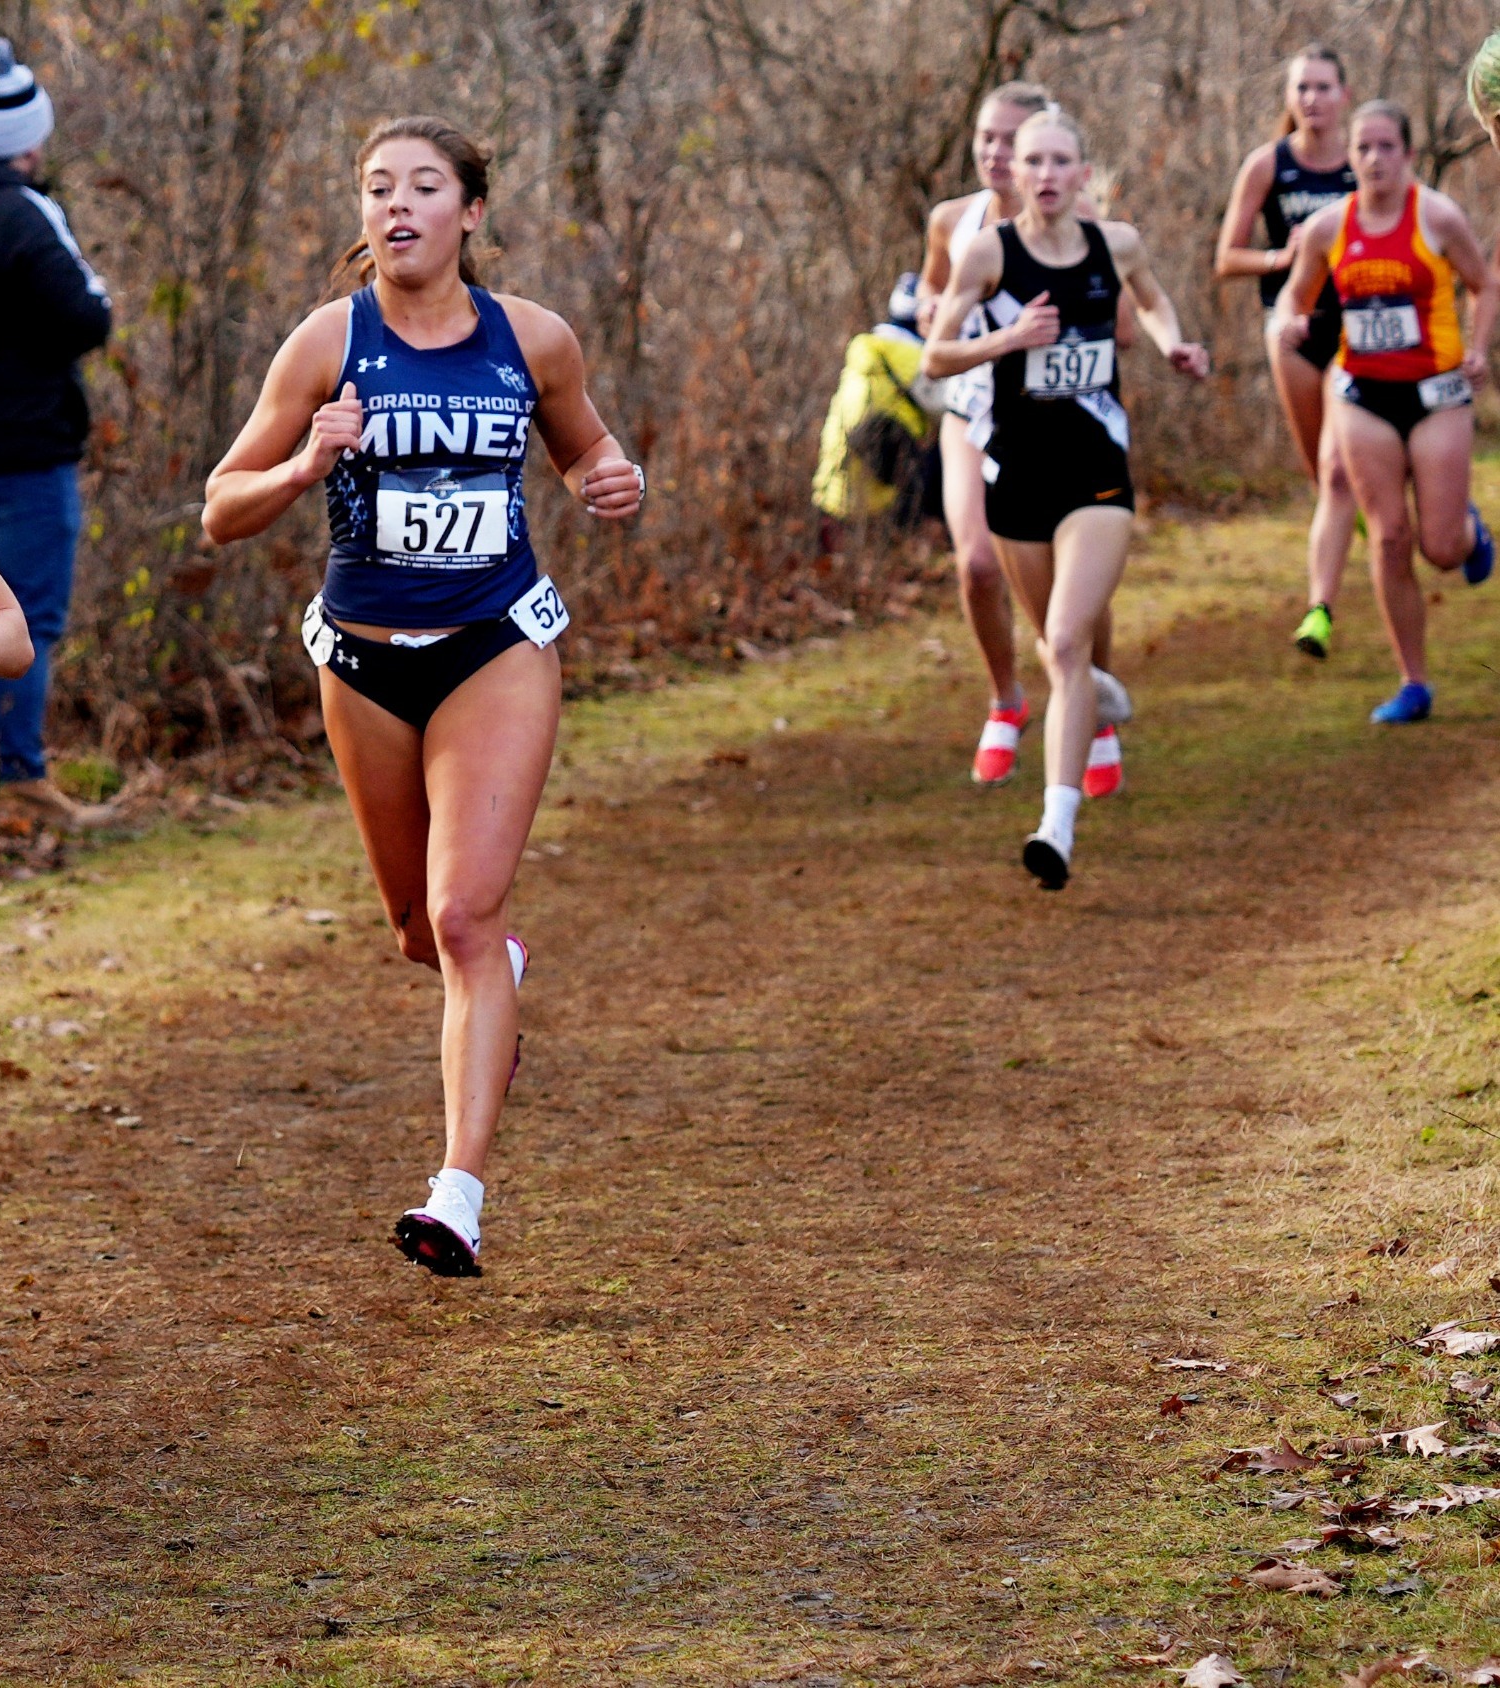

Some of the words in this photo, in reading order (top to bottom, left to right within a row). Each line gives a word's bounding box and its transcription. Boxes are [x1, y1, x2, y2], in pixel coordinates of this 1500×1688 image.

[1044, 348, 1099, 387] 597
[361, 393, 441, 412] ORADO
[448, 395, 524, 413] SCHOOL
[342, 411, 531, 461] MINES
[403, 501, 485, 553] 527
[530, 586, 564, 629] 52
